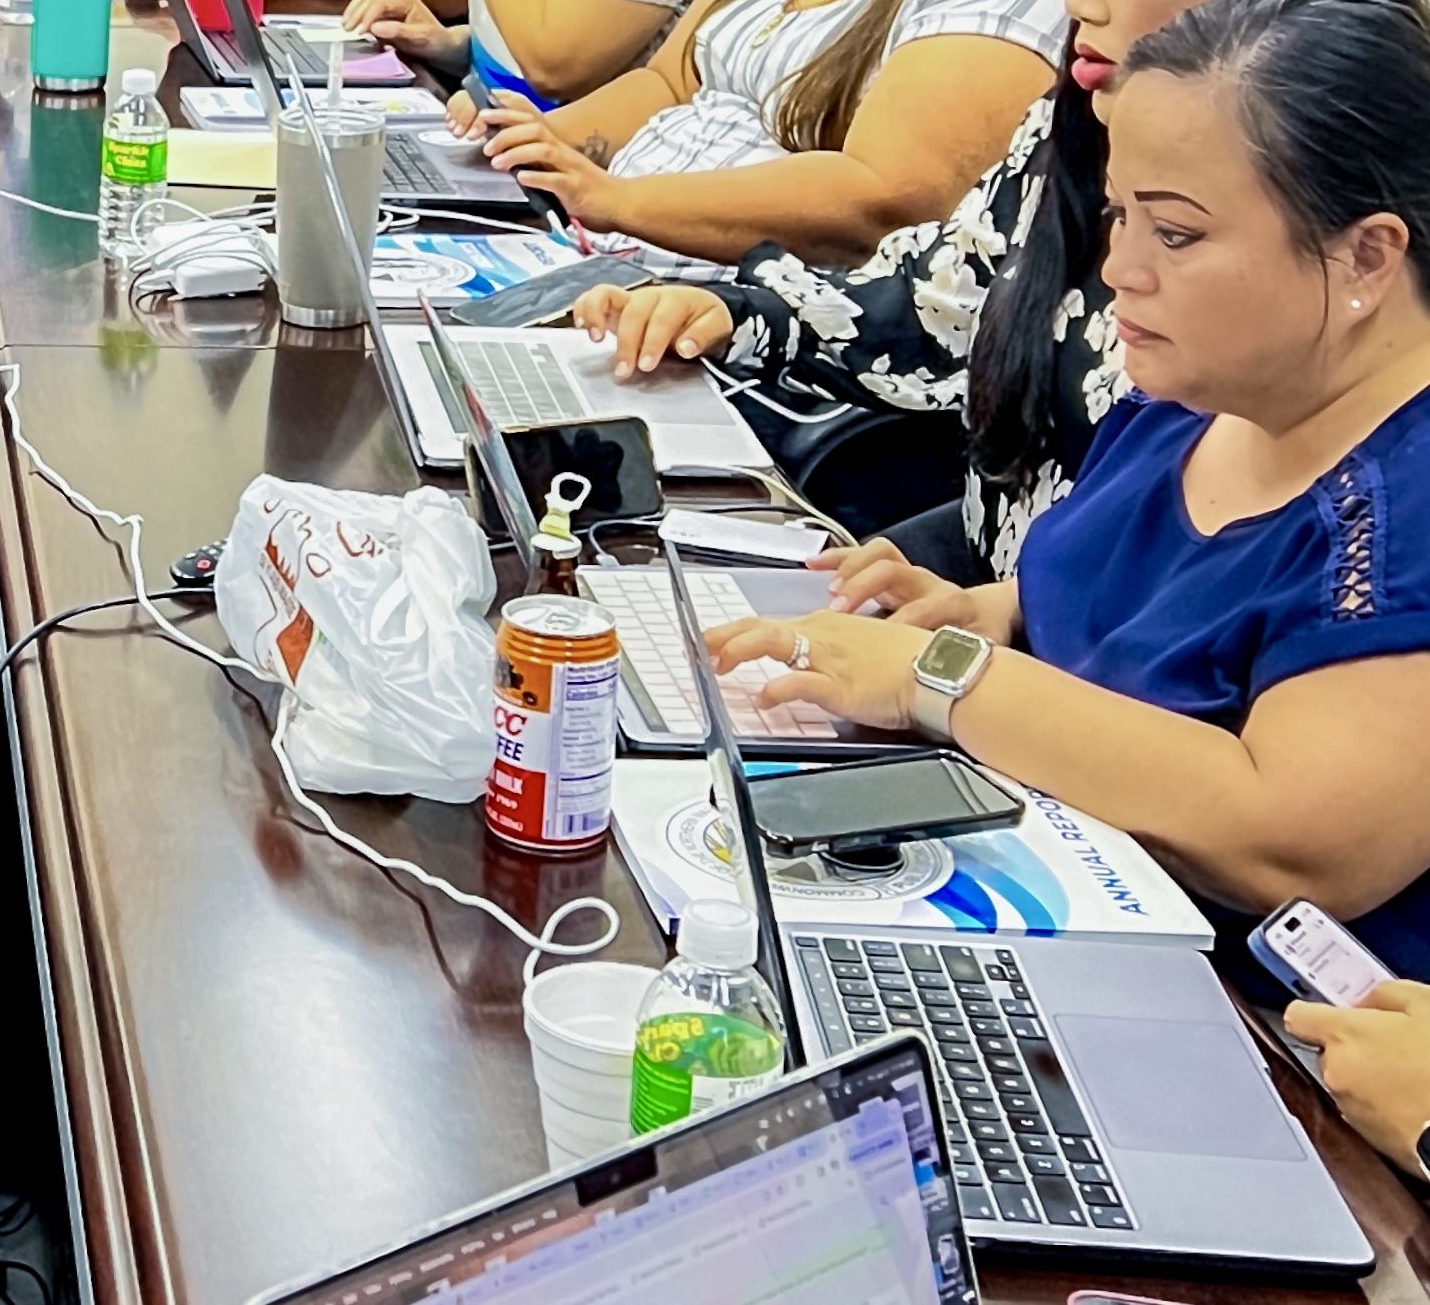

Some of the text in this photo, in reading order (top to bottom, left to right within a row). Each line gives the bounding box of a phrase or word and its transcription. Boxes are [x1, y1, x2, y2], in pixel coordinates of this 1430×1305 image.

[494, 705, 527, 736] CC
[496, 737, 524, 762] FEE
[1027, 788, 1150, 916] ANNUAL REPOR
